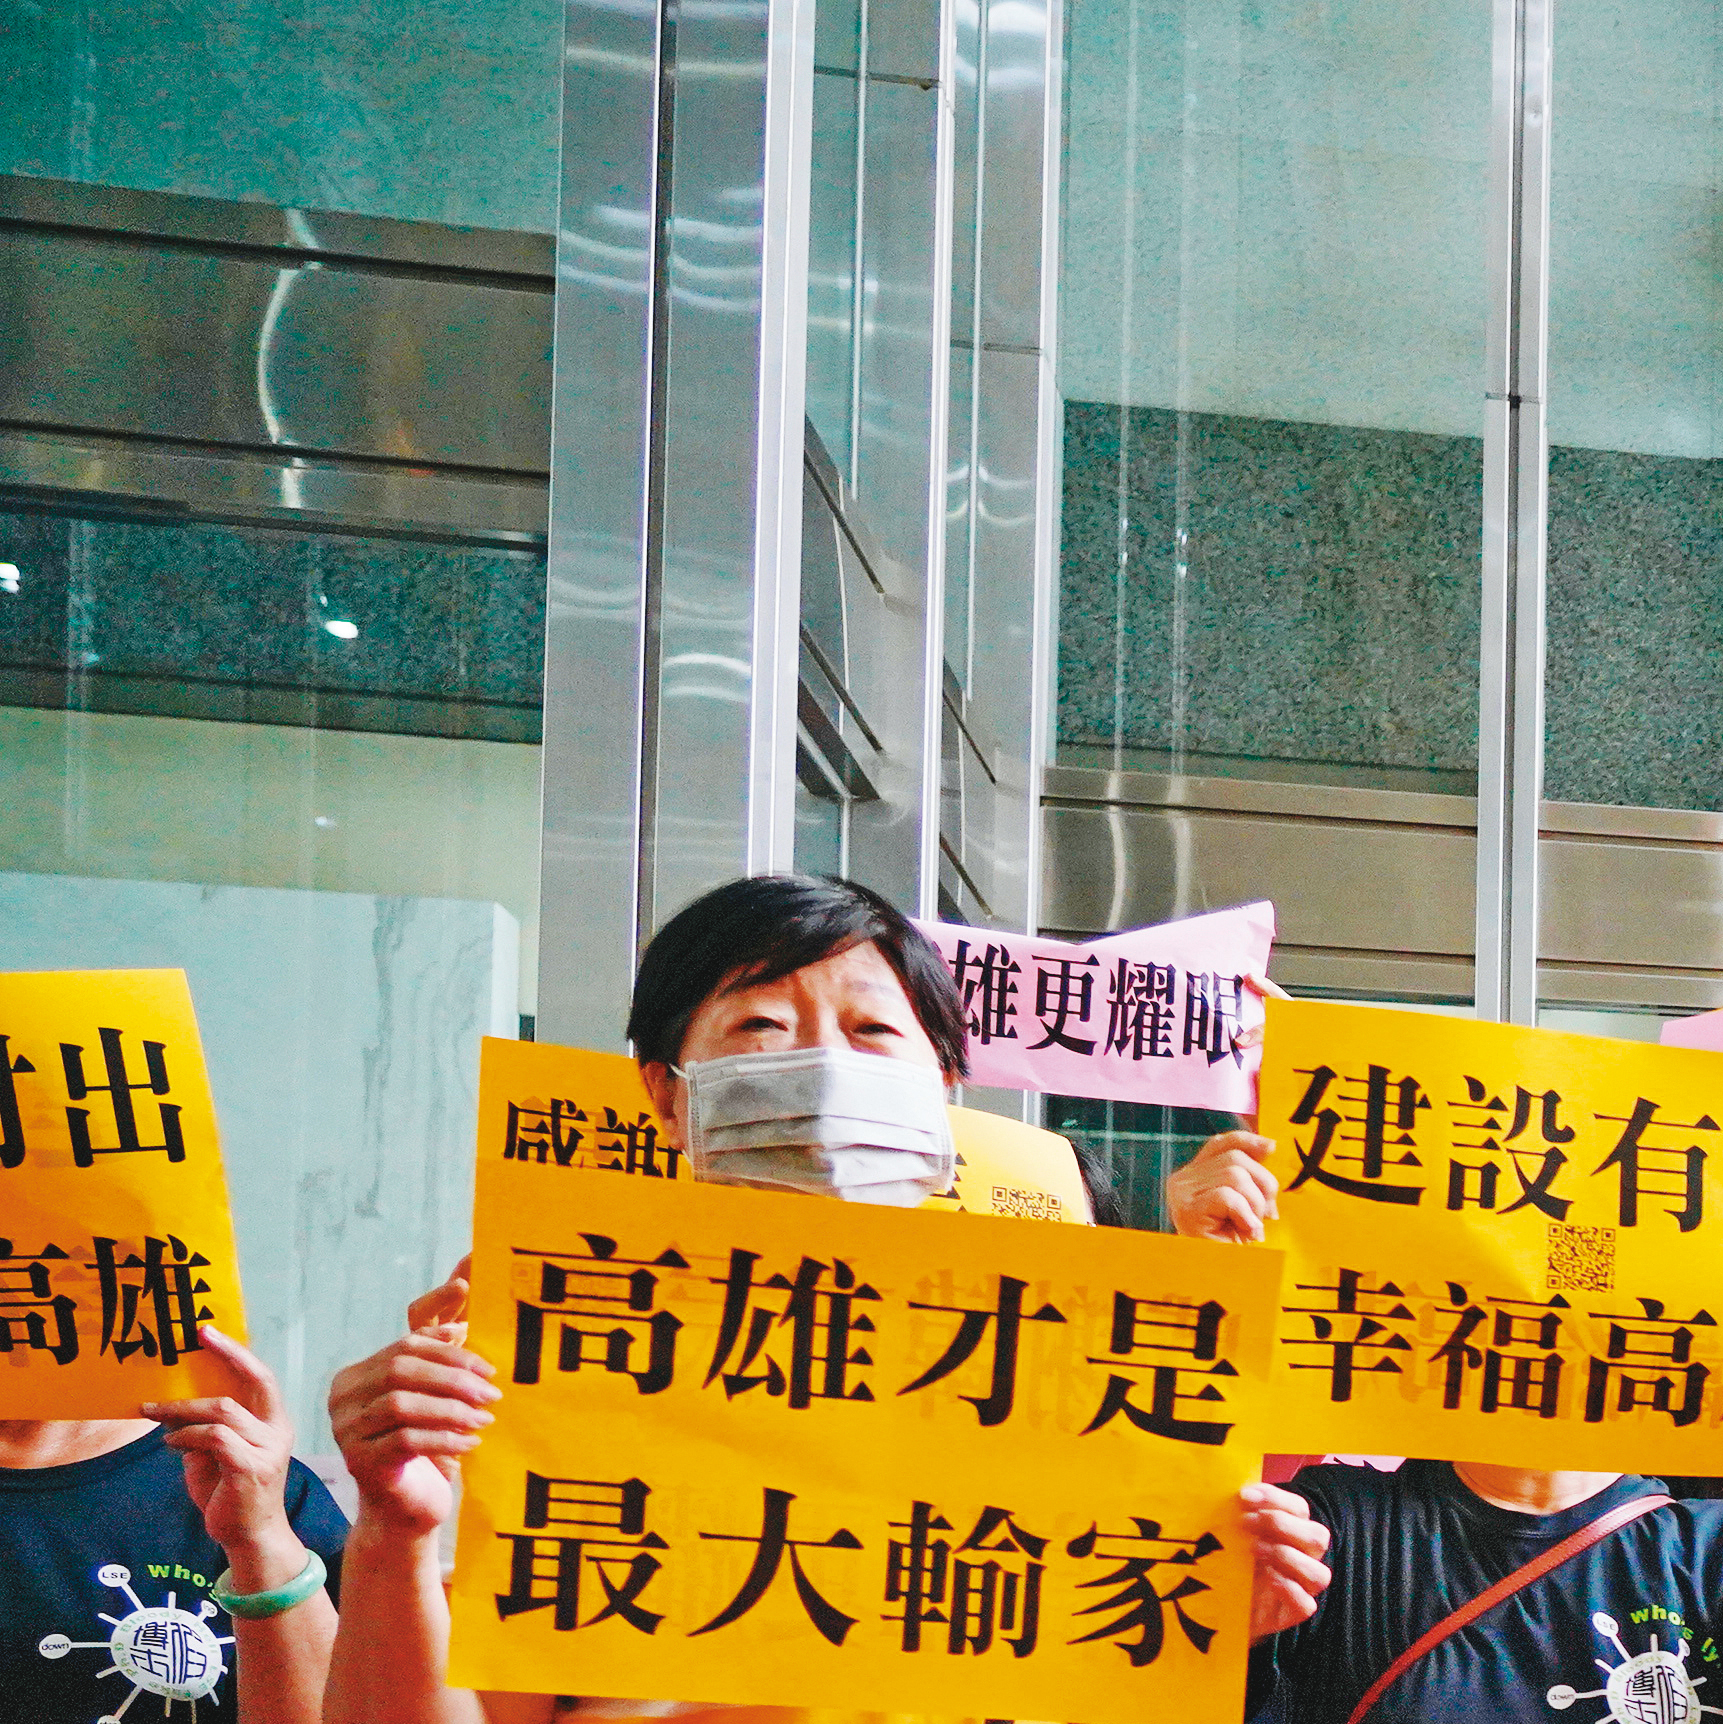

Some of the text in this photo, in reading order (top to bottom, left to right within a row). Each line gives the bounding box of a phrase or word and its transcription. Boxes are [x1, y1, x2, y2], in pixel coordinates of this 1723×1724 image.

[511, 1232, 1241, 1446] 高雄才是
[101, 1571, 129, 1580] LSE
[494, 1470, 1223, 1668] 最大輸家
[41, 1641, 70, 1651] down
